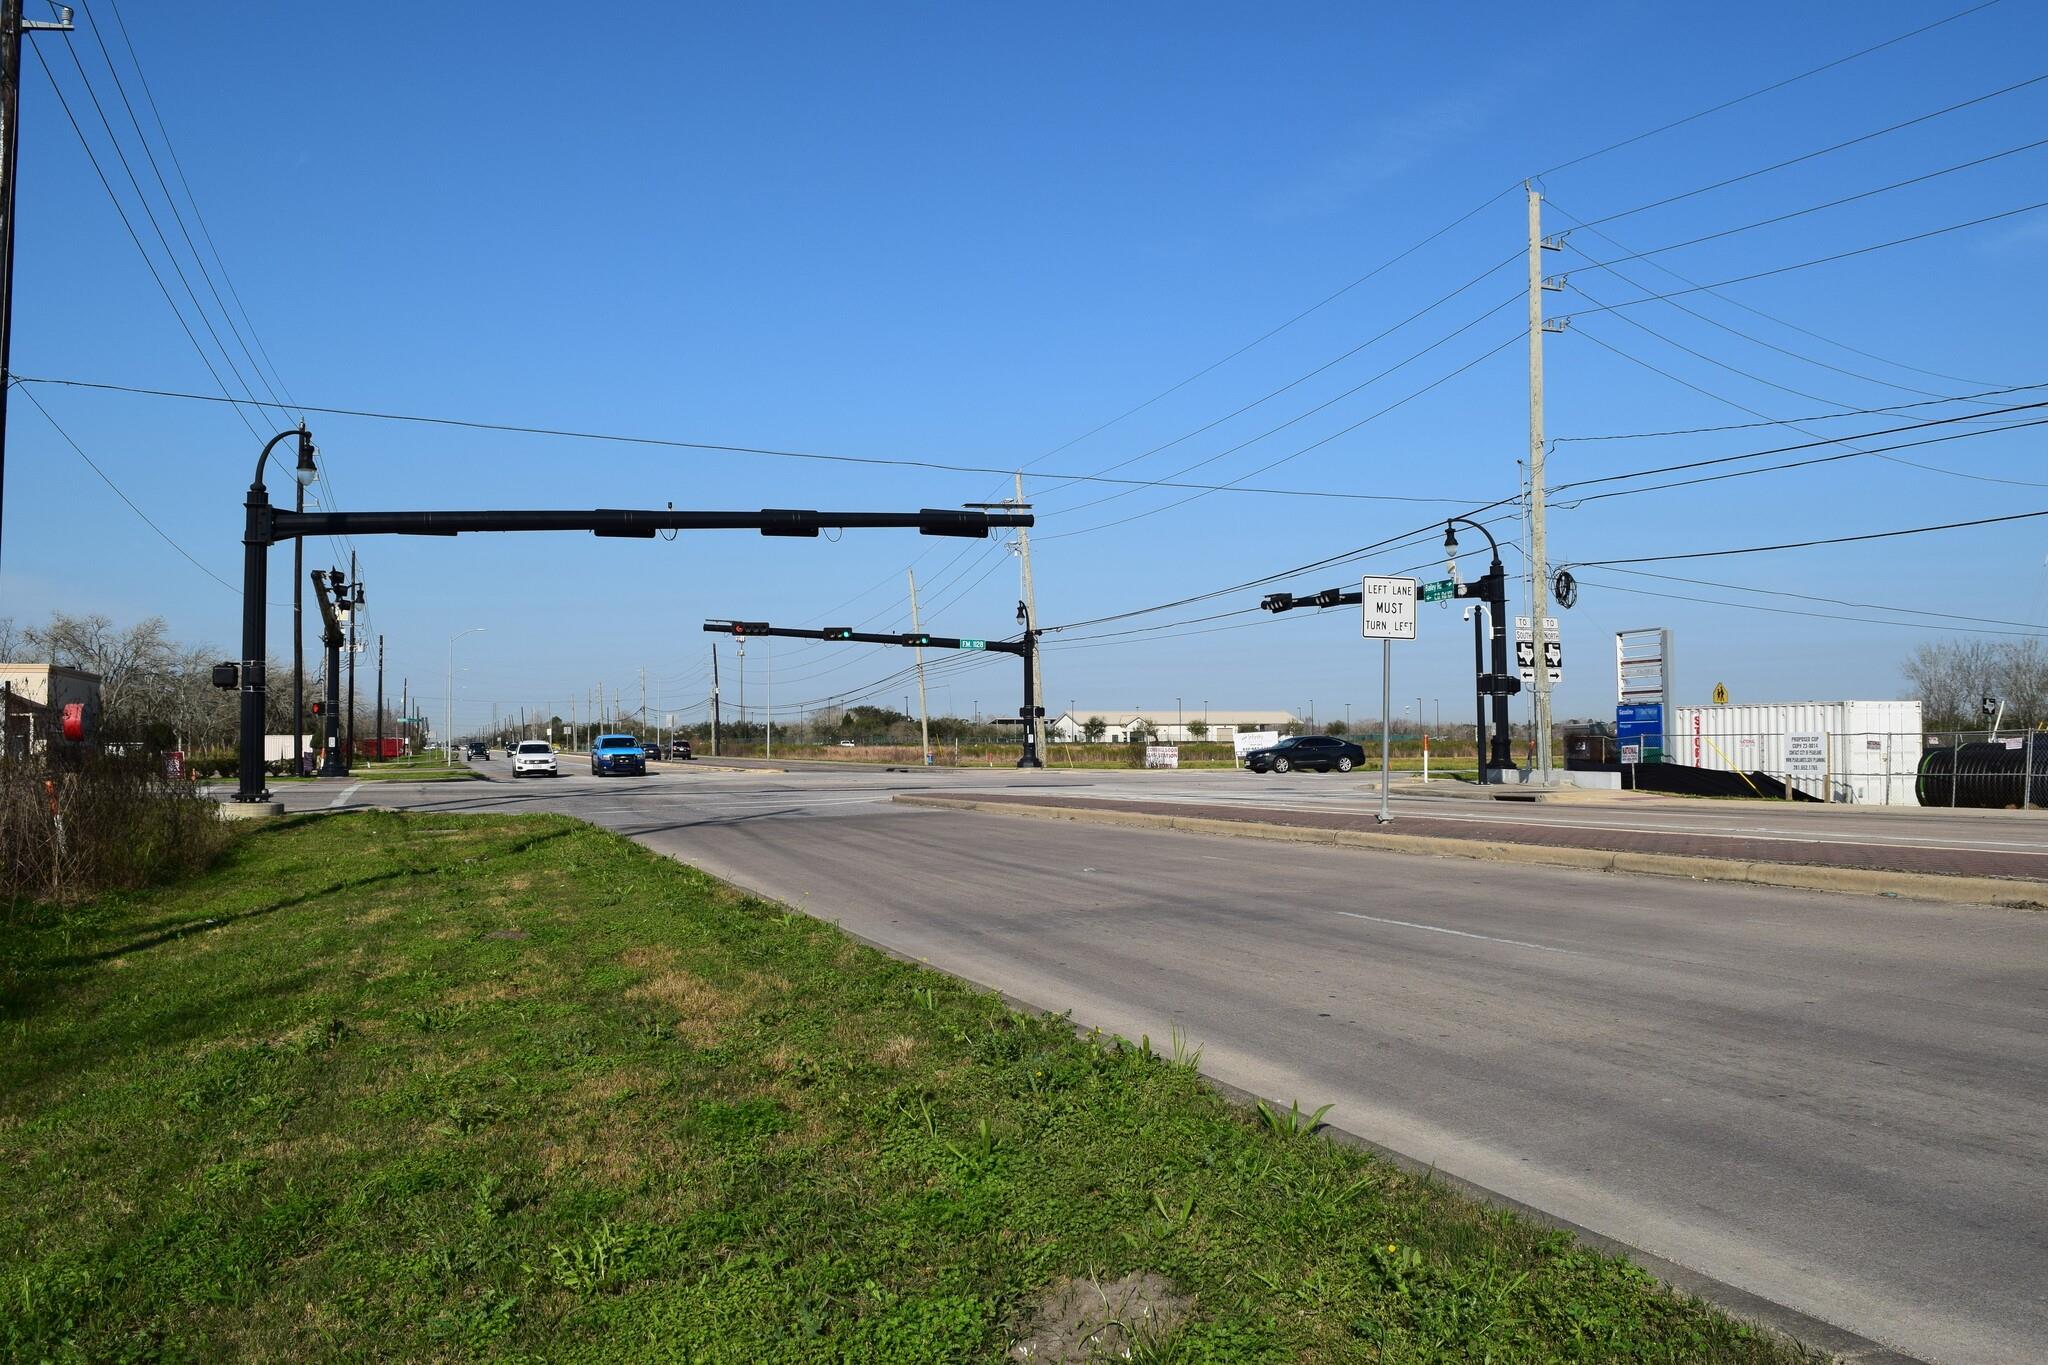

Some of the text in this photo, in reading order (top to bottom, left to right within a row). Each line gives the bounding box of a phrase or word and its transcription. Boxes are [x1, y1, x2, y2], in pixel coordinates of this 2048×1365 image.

[1368, 585, 1412, 596] LEFT LANE
[1376, 602, 1403, 614] MUST
[1366, 620, 1413, 631] TURN LEFT
[1517, 631, 1532, 639] SOUTH
[1544, 631, 1559, 640] NORTH
